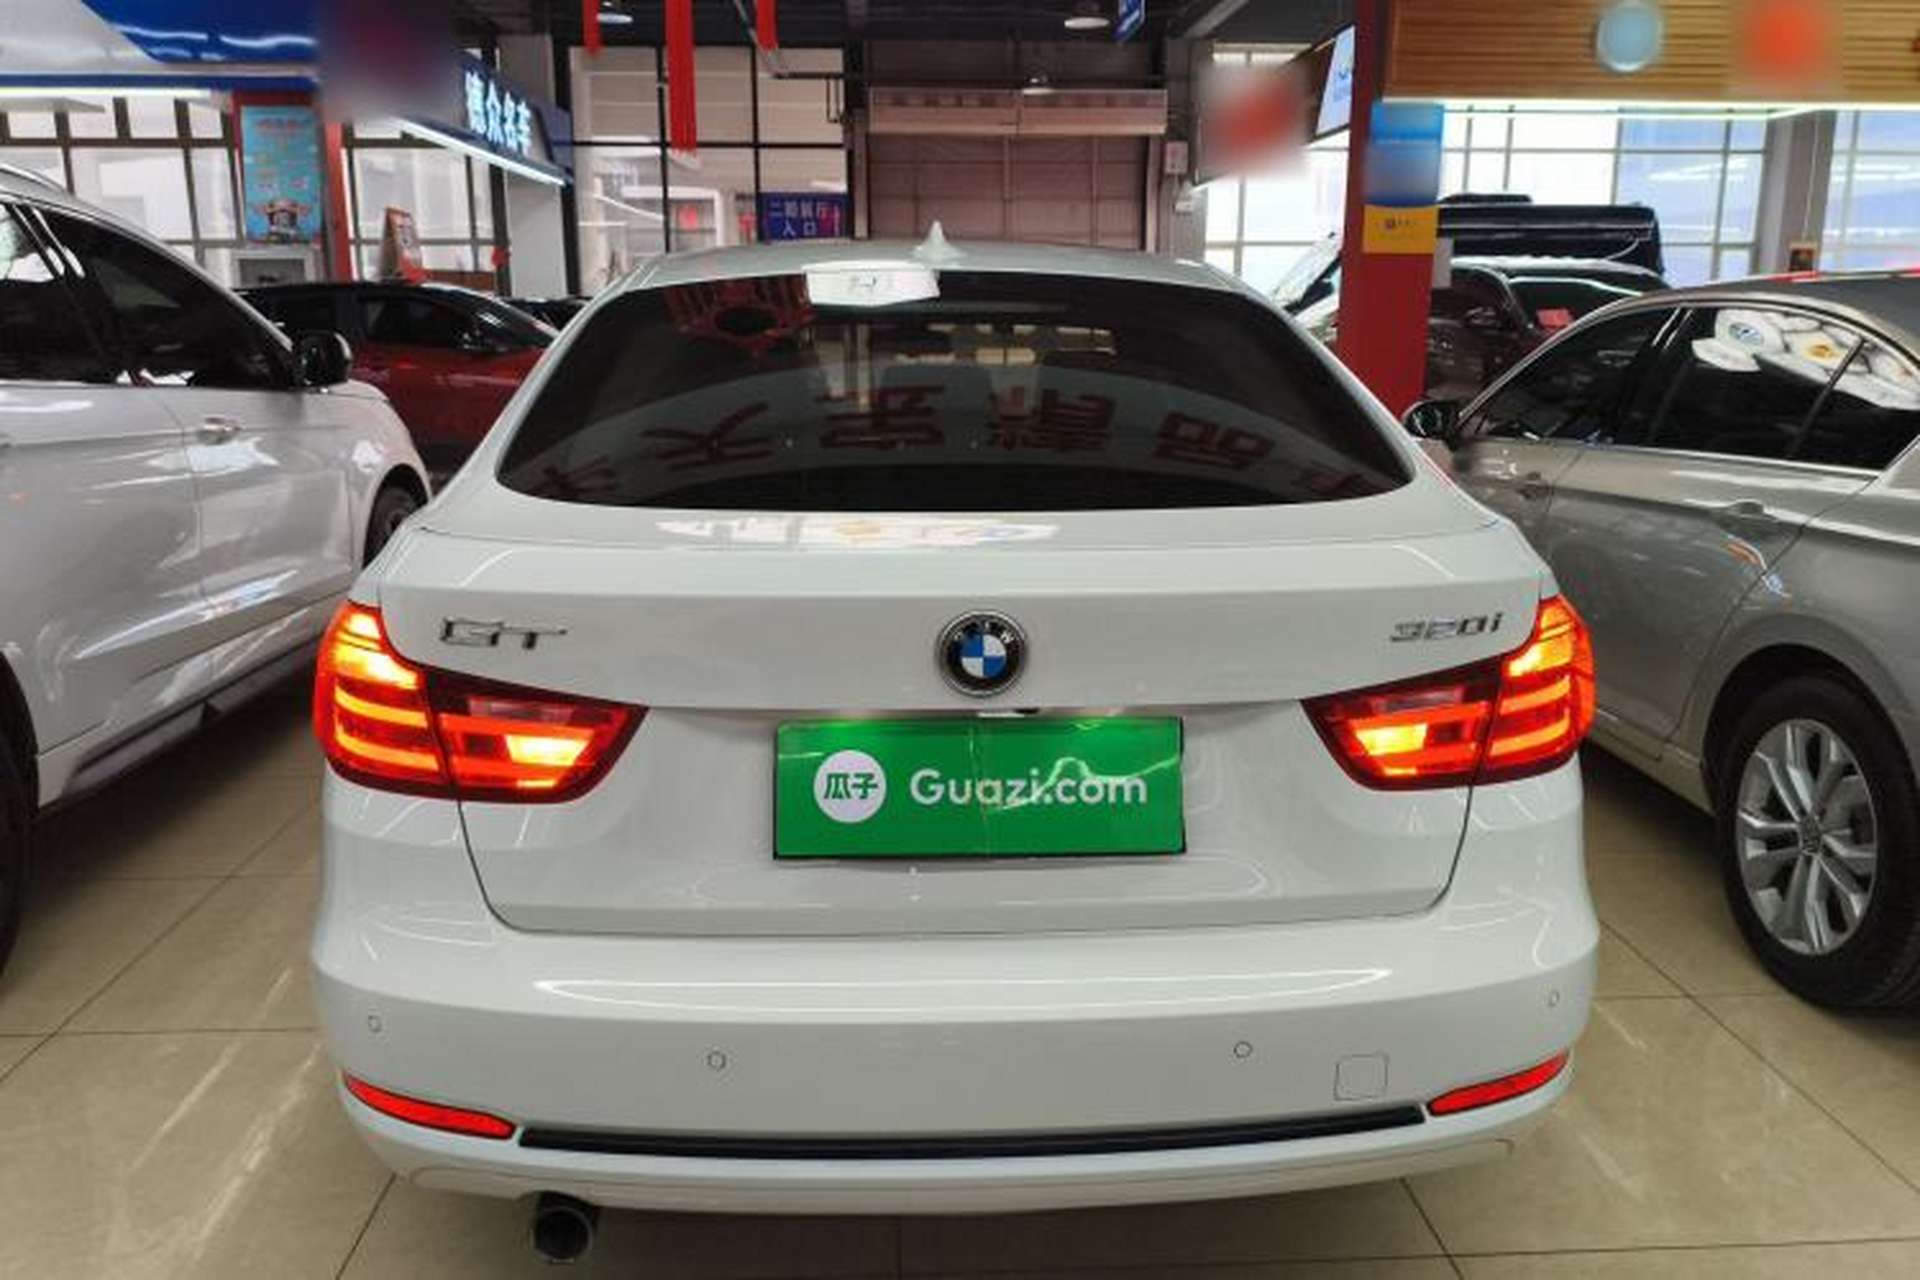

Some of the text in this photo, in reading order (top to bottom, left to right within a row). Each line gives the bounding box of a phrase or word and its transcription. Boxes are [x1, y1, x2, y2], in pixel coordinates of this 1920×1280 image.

[782, 219, 817, 236] 入口
[439, 616, 568, 650] GT
[1389, 612, 1504, 643] 320i
[824, 772, 878, 799] 瓜子
[909, 768, 1148, 805] Guazi.com
